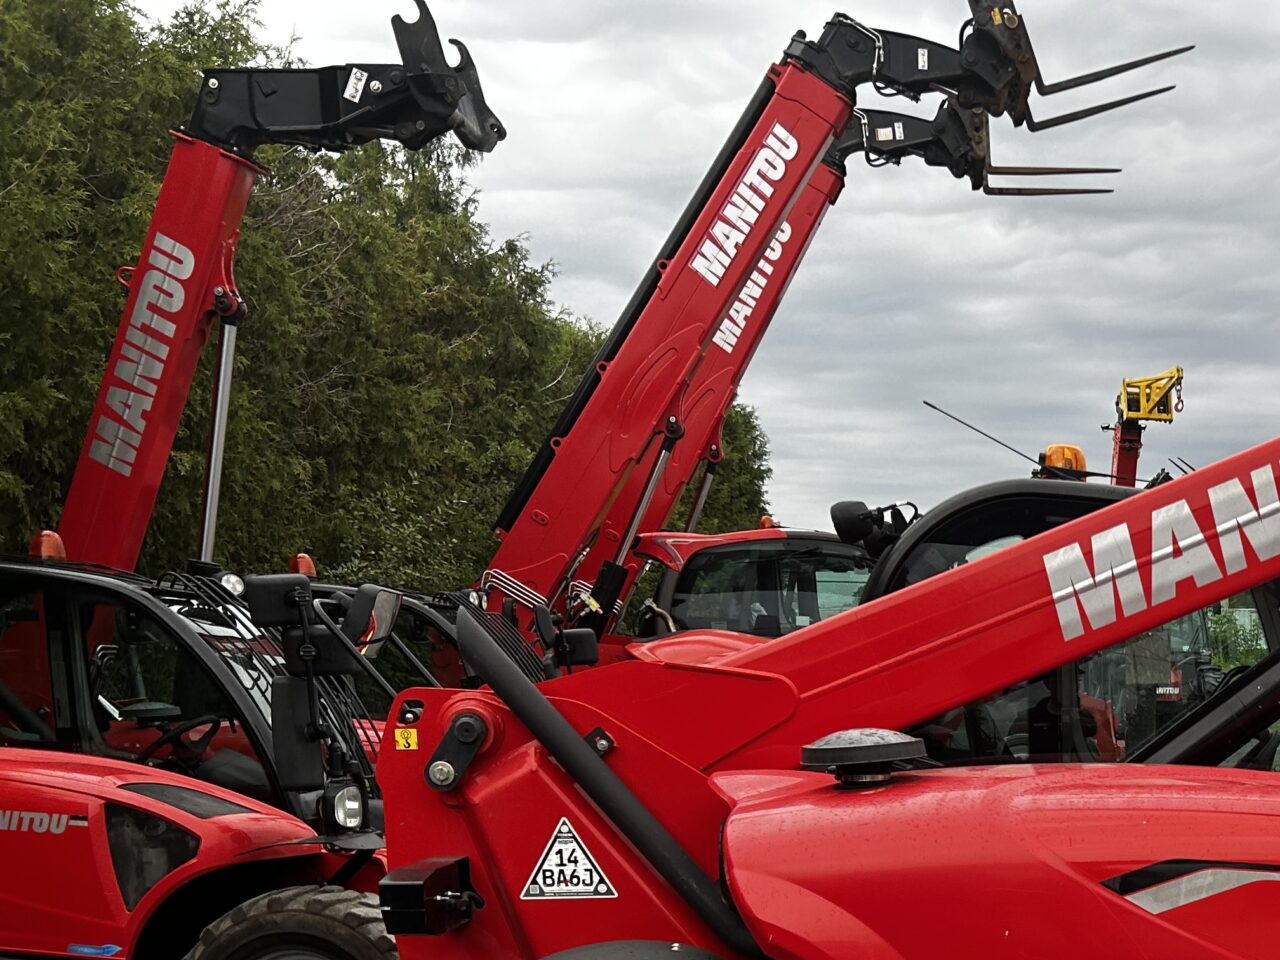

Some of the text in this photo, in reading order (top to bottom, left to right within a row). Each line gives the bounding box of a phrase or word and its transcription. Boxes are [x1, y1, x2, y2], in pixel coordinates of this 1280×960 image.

[690, 122, 798, 287] MANITOU
[88, 231, 195, 478] MANITOU
[542, 868, 594, 888] BA6J
[555, 848, 579, 867] 14
